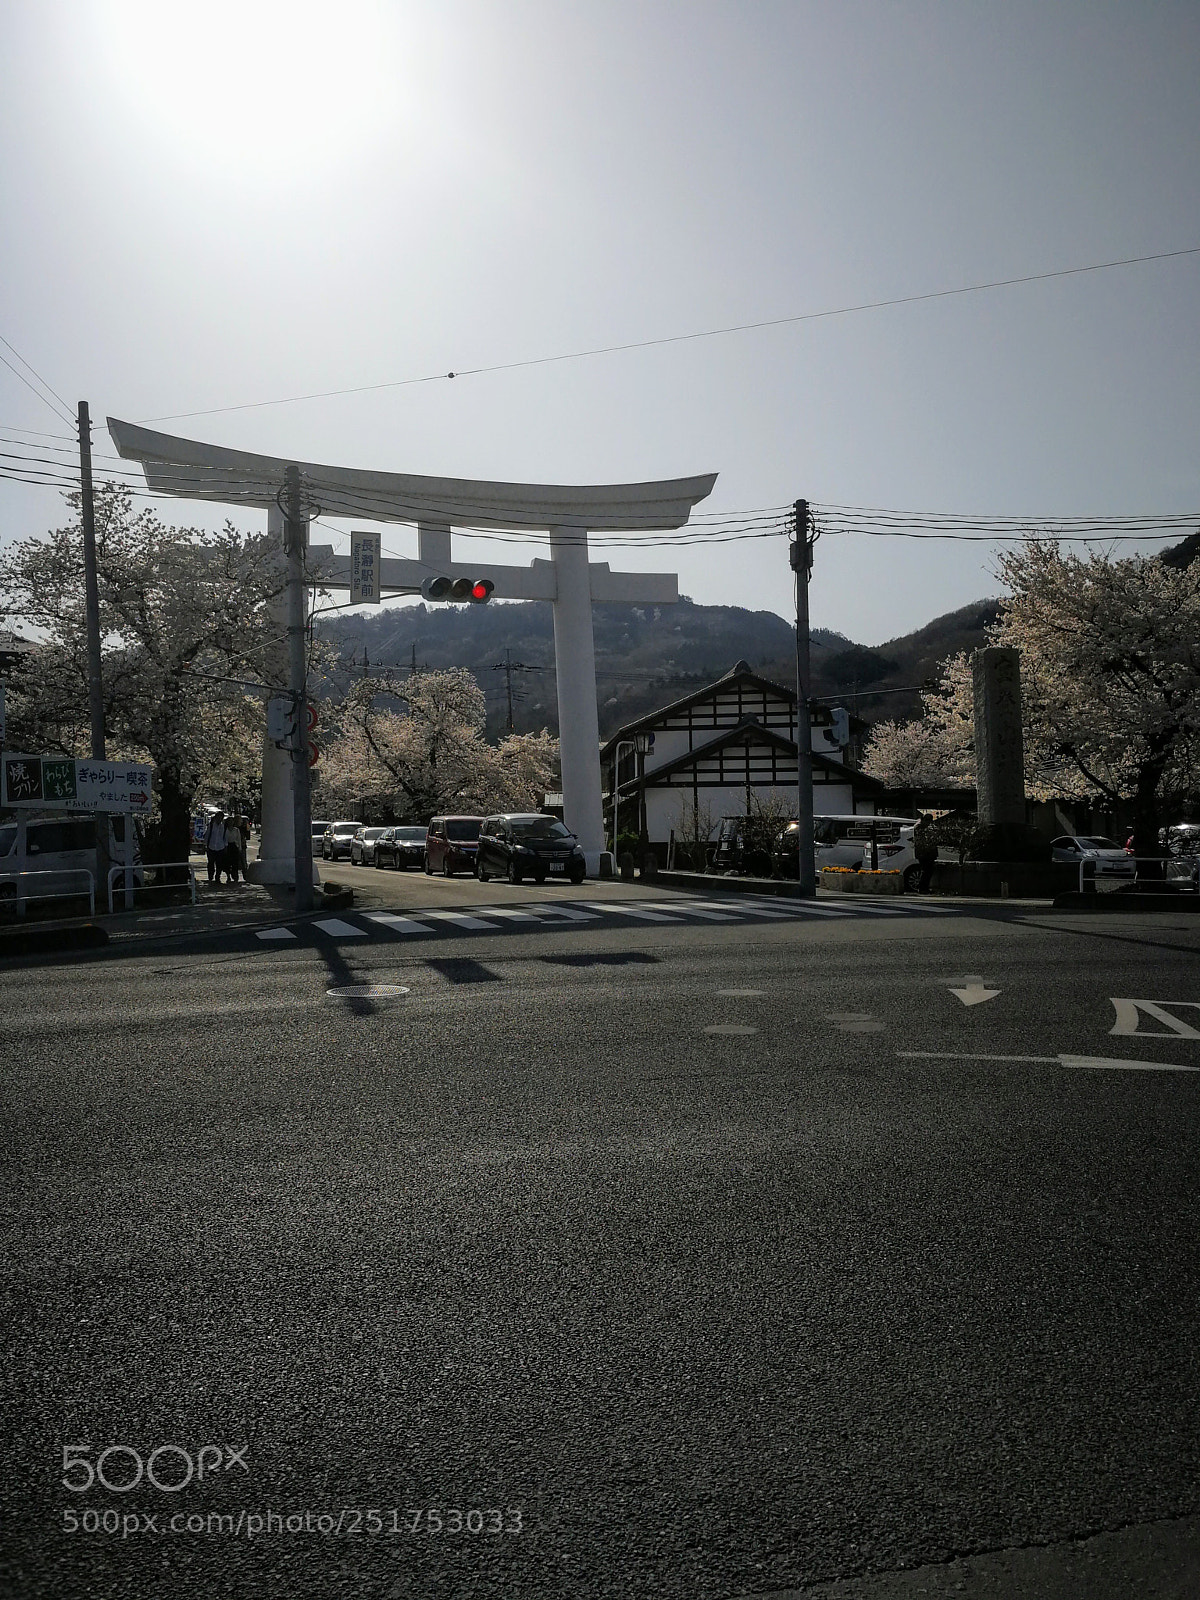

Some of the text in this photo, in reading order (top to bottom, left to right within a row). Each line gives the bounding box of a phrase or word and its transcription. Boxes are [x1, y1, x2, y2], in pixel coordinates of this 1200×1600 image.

[353, 542, 361, 575] Nagatoro
[10, 763, 30, 782] 焼
[46, 763, 70, 782] わらび
[54, 780, 73, 797] もち
[99, 791, 128, 802] やました
